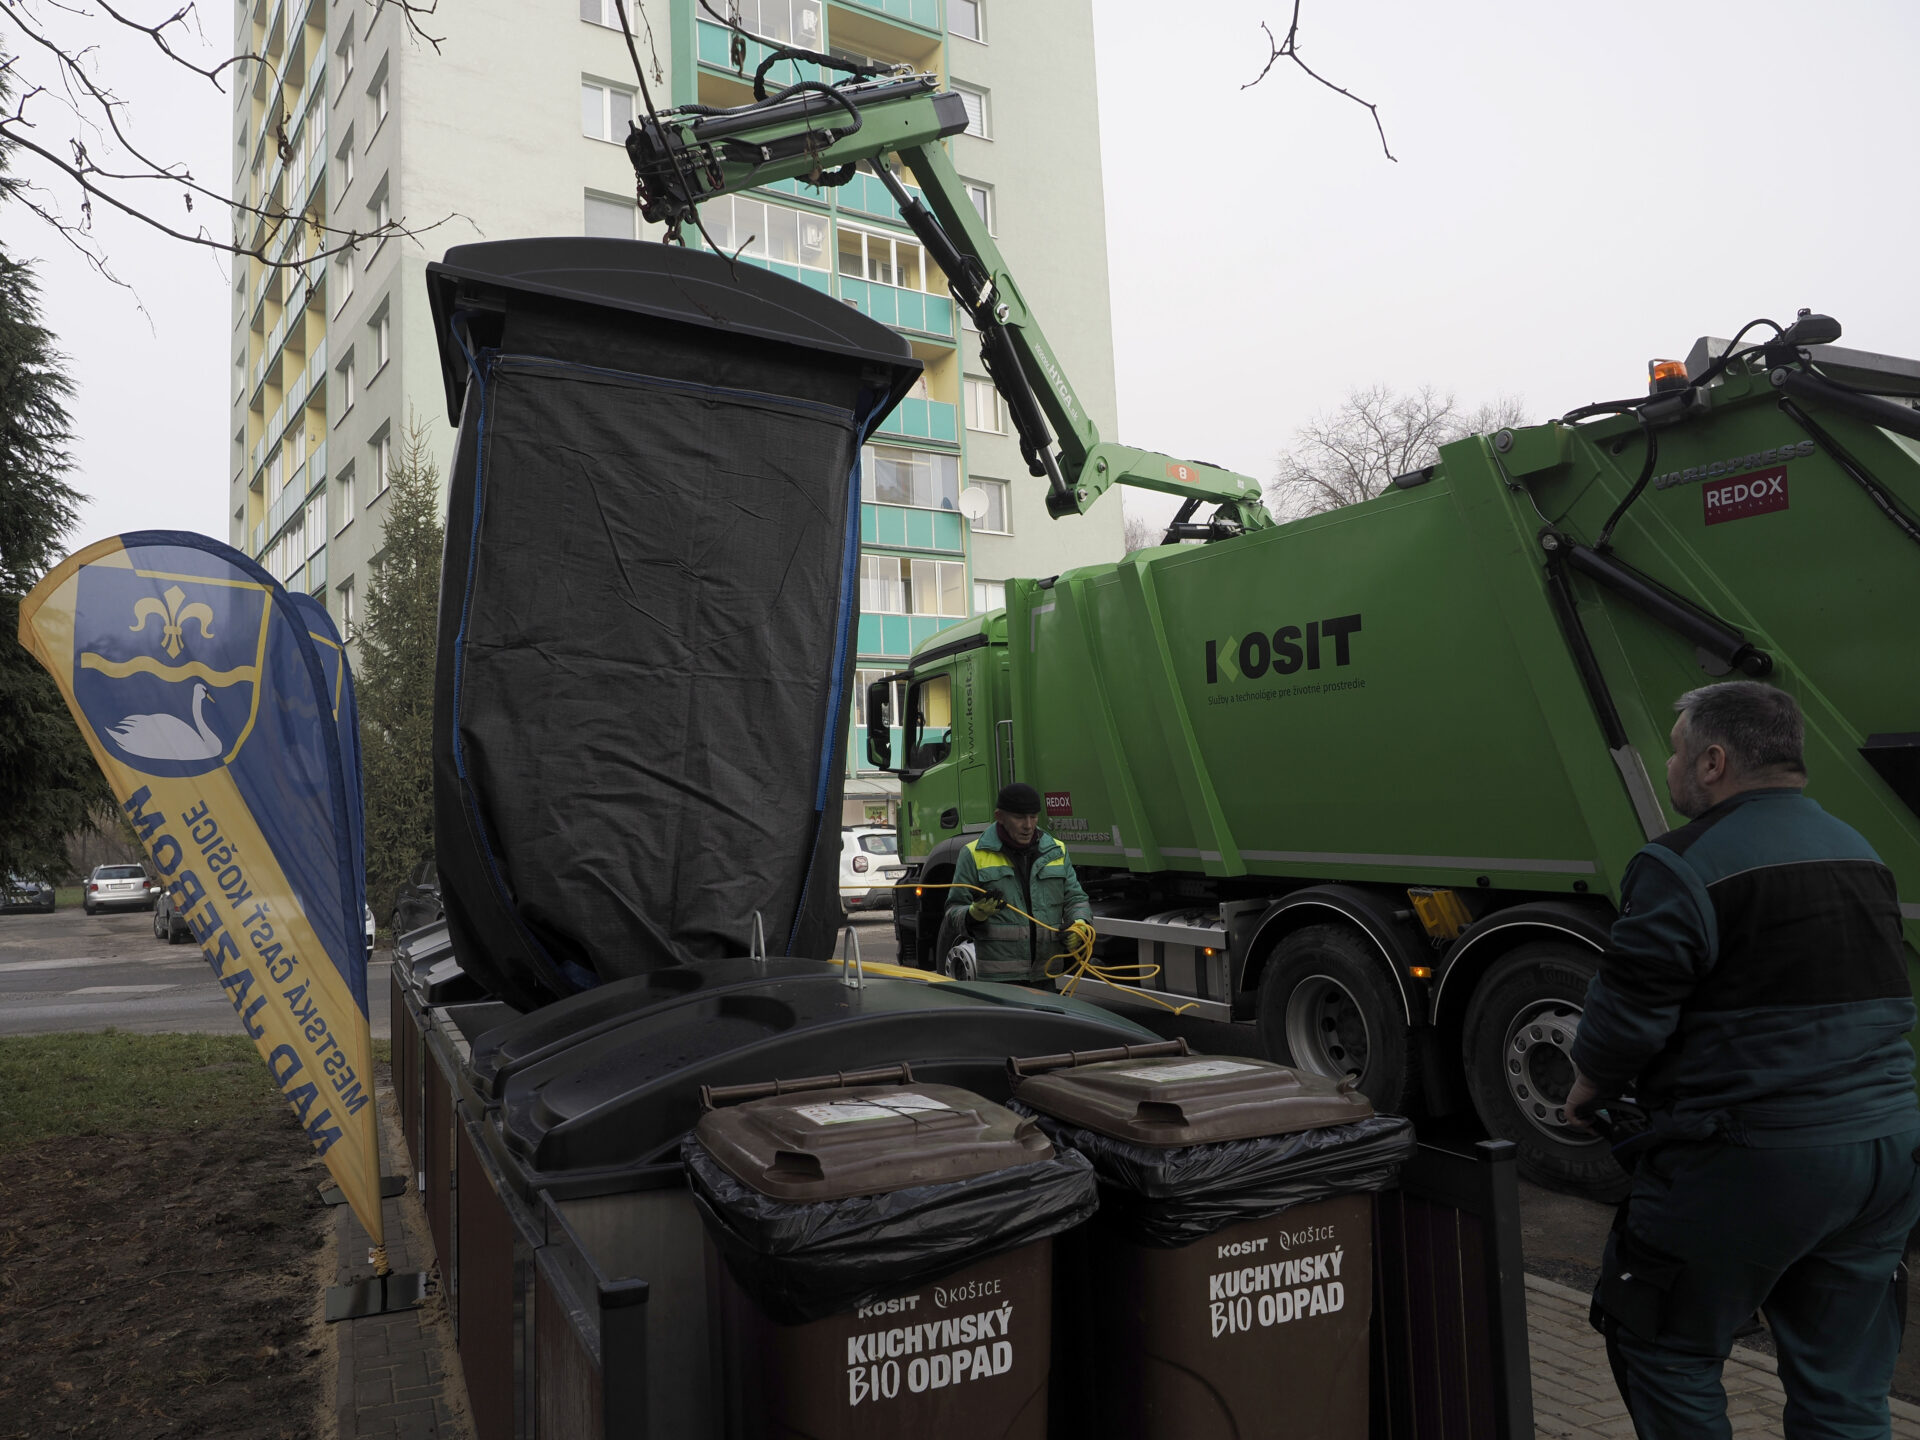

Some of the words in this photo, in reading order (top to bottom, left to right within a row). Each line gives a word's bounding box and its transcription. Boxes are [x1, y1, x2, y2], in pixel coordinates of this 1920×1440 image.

[1178, 466, 1187, 480] 8
[1653, 440, 1815, 490] VARIOPRESS
[1706, 475, 1784, 508] REDOX
[1205, 613, 1362, 684] KOSIT
[965, 654, 976, 765] www.kosit.sk
[1278, 687, 1291, 698] pre
[1323, 678, 1366, 692] prostredie
[1046, 797, 1070, 807] REDOX
[1218, 1237, 1269, 1259] KOSIT
[1292, 1225, 1335, 1245] KOŠICE
[950, 1279, 1001, 1302] KOŠICE
[1209, 1245, 1344, 1301] KUCHYNSKÝ
[847, 1300, 1013, 1365] KUCHYNSKÝ
[1209, 1296, 1252, 1338] BIO
[1257, 1281, 1345, 1327] ODPAD
[847, 1360, 900, 1407] BIO
[907, 1341, 1013, 1393] ODPAD
